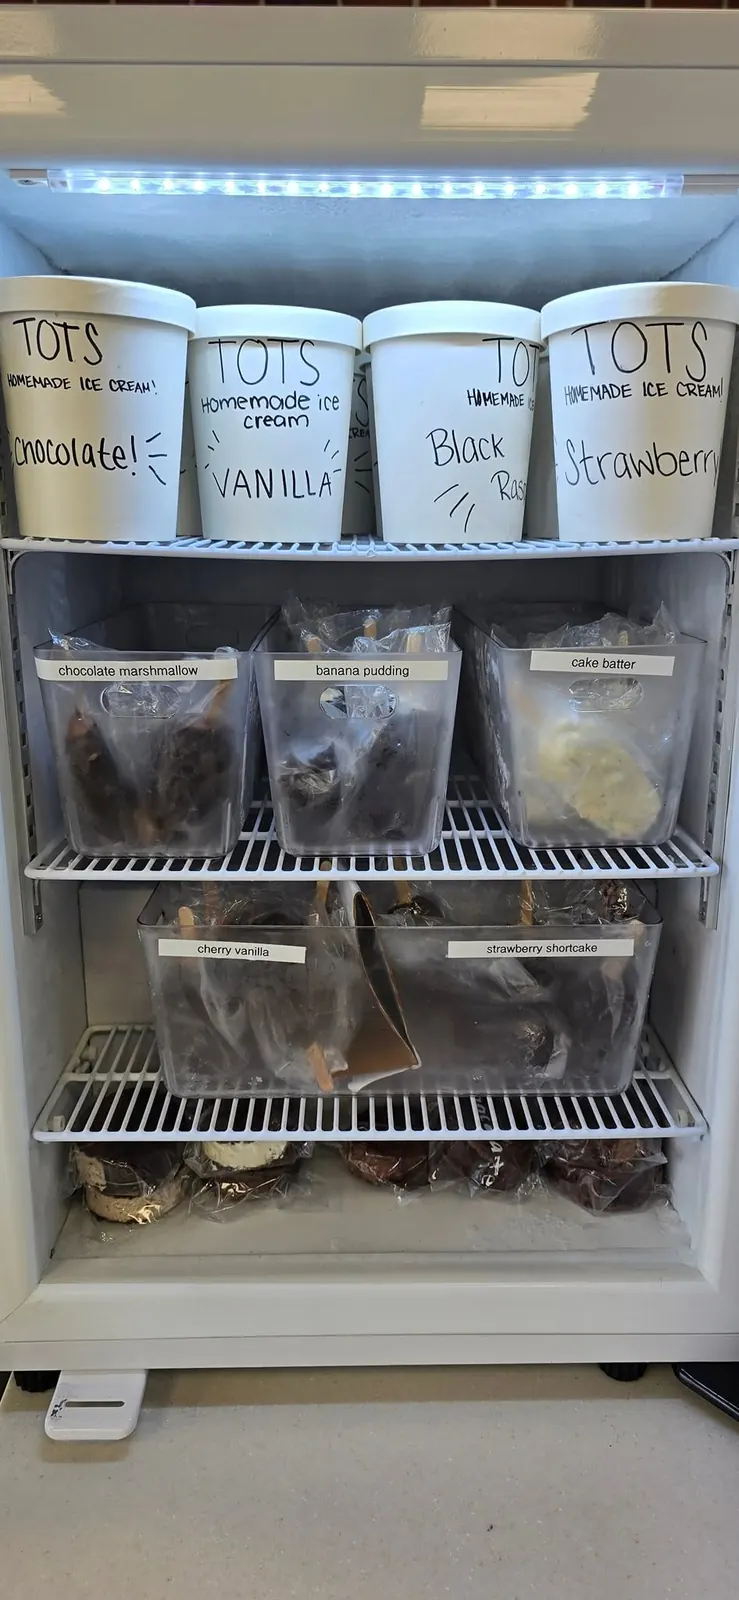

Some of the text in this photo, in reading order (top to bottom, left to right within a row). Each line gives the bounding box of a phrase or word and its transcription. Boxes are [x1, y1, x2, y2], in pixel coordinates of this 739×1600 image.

[13, 316, 103, 366] TOTS
[571, 321, 708, 382] TOTS
[208, 338, 320, 386] TOTS
[7, 373, 157, 395] HOMEMADE ICE CREAM!
[563, 377, 724, 405] HOMEMADE ICE CREAM!
[201, 390, 340, 413] Homemade ice
[467, 388, 525, 408] HOMEMADE
[243, 414, 310, 429] cream
[425, 428, 505, 466] Black
[565, 438, 720, 487] Strawberry
[212, 468, 332, 499] VANILLA
[490, 470, 527, 501] Ras
[58, 664, 198, 677] chocolate marshmallow
[316, 664, 410, 678] banana pudding
[571, 657, 636, 670] cake batter
[197, 944, 269, 957] cherry vanilla
[487, 943, 598, 955] strawberry shortcake
